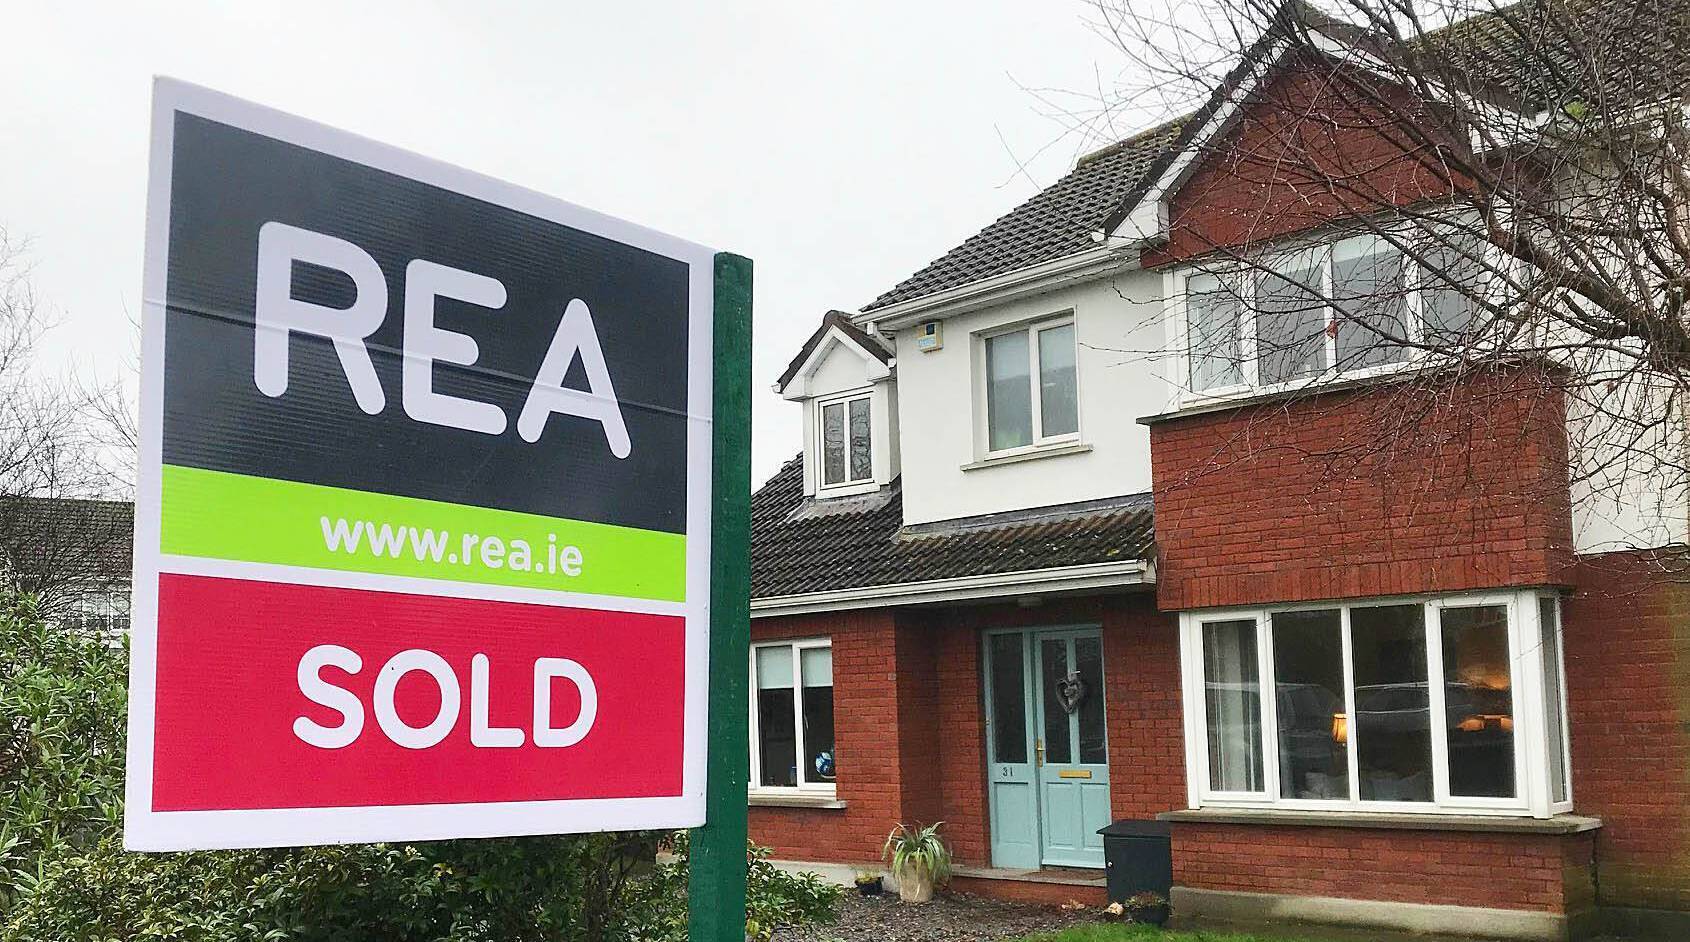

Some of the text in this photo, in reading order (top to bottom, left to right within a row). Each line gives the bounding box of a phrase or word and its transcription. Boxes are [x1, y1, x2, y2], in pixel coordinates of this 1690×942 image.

[253, 221, 632, 460] REA
[320, 515, 584, 578] www.rea.ie
[292, 643, 598, 750] SOLD
[1002, 766, 1014, 777] 31
